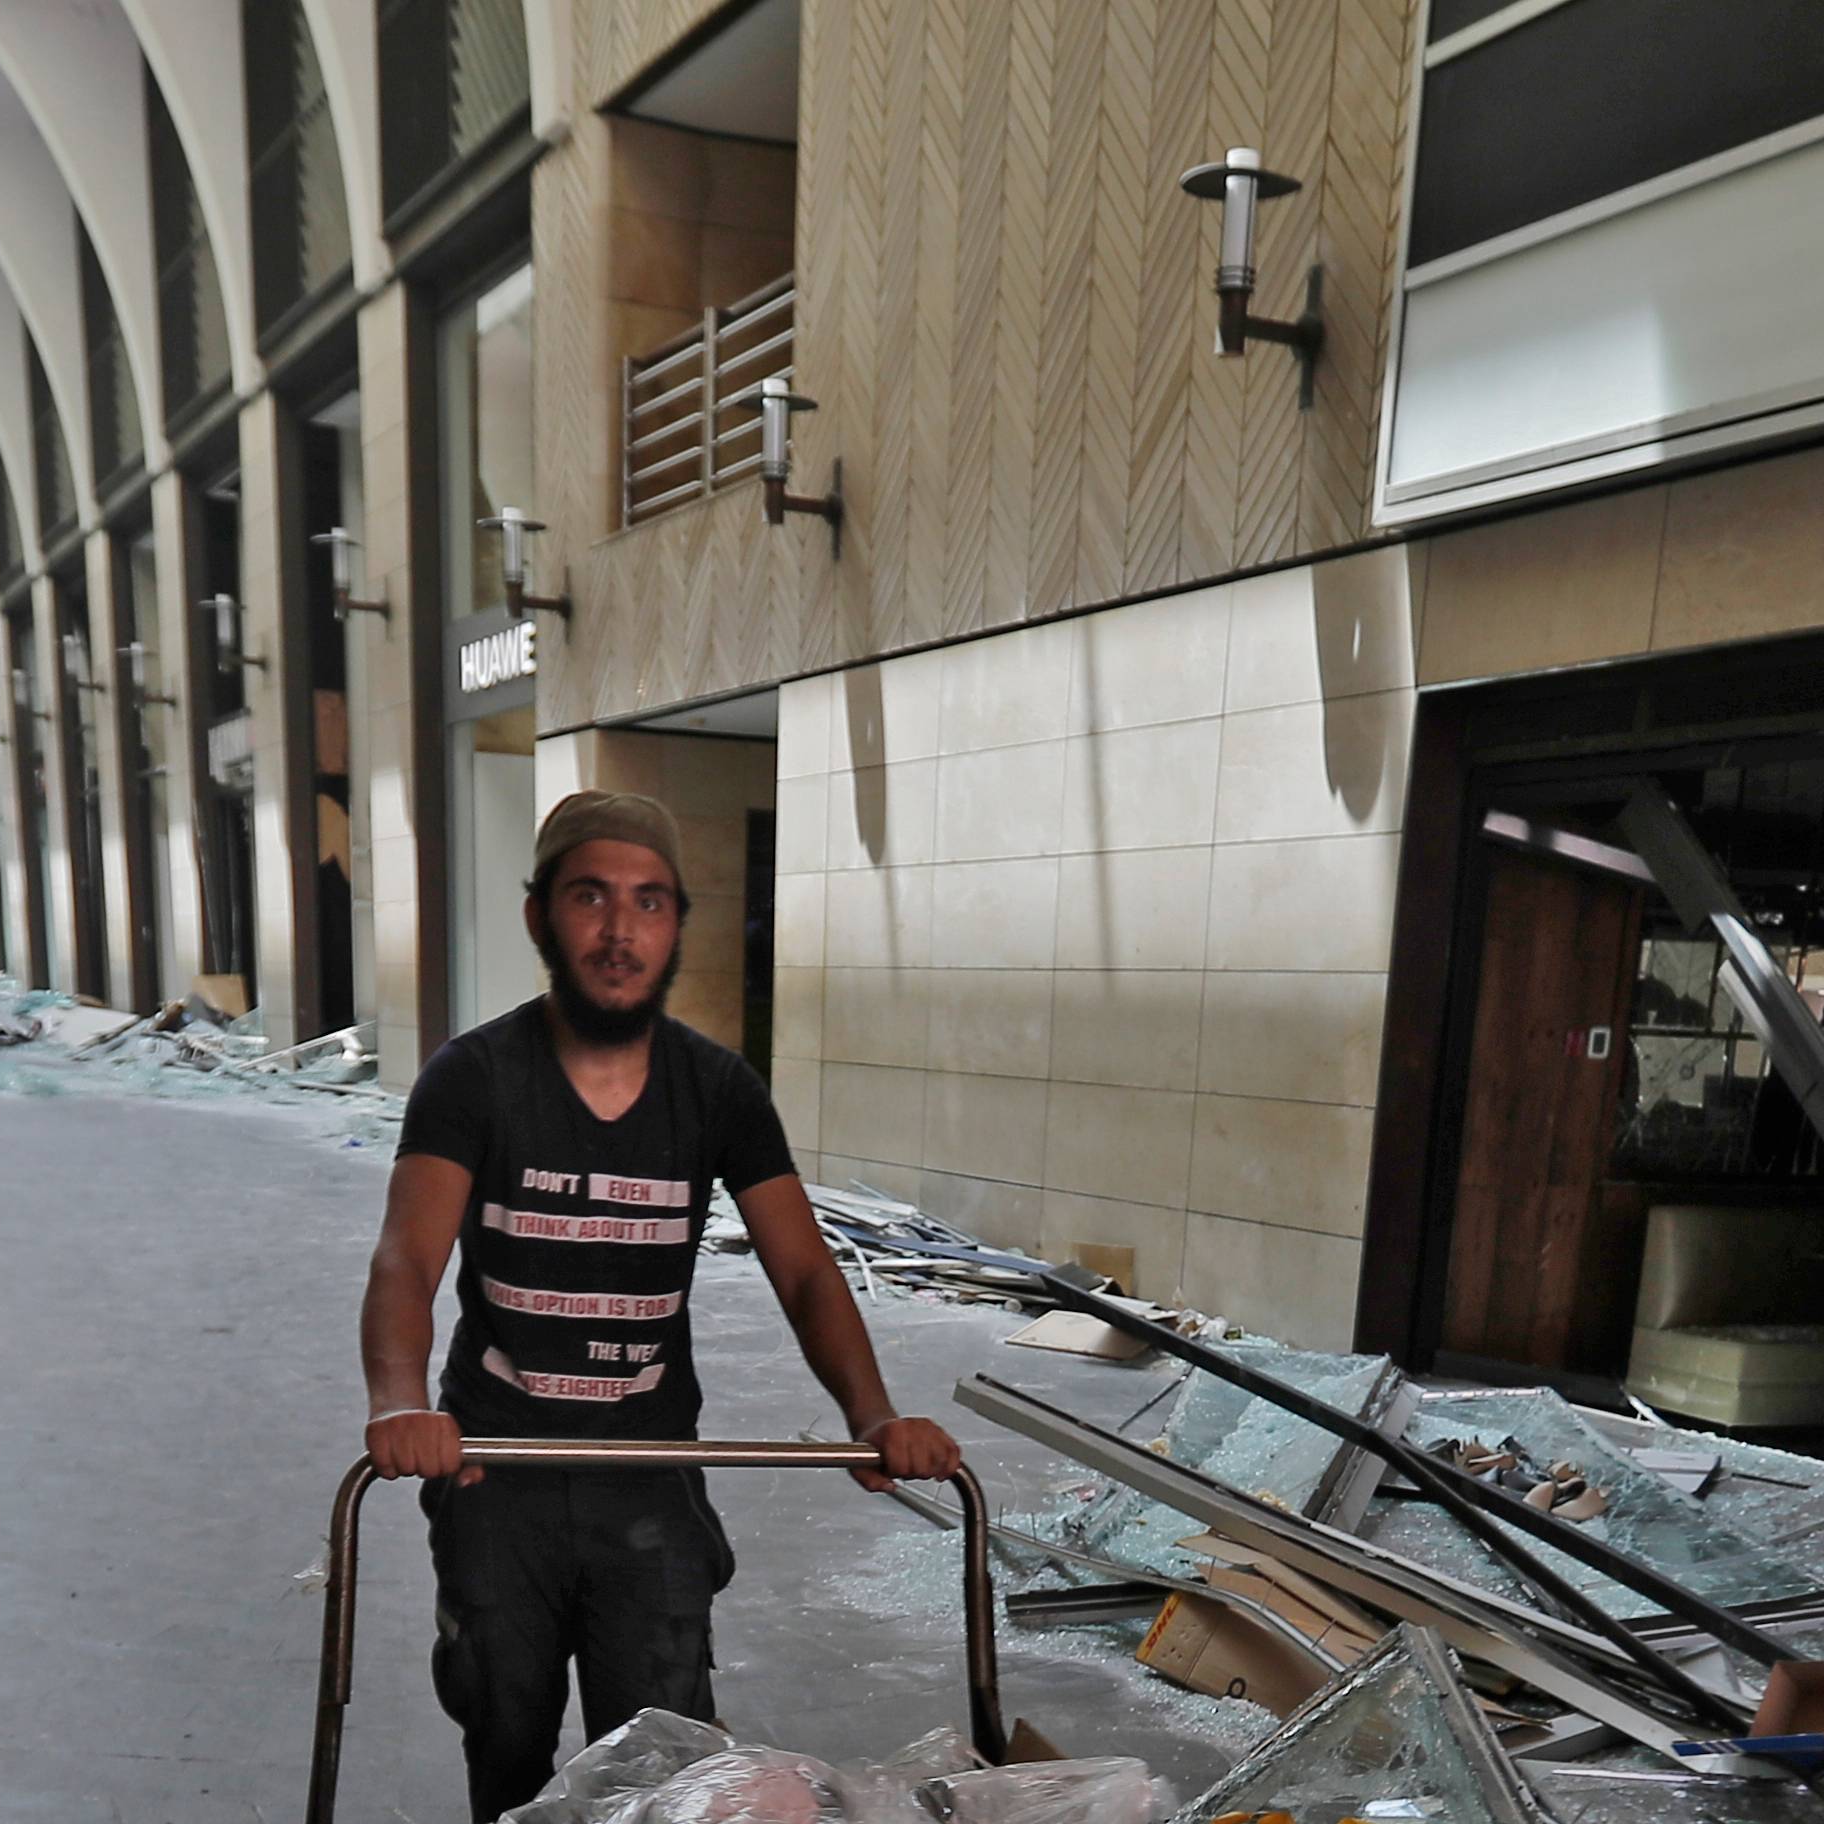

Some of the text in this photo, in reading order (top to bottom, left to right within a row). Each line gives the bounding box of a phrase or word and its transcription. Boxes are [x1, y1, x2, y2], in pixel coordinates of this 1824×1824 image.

[461, 621, 536, 693] HUAWE
[522, 1168, 651, 1201] DON'T EVEN
[514, 1215, 659, 1240] THINK ABOUT IT
[533, 1294, 599, 1314] OPTION
[608, 1298, 626, 1316] IS
[635, 1299, 668, 1318] FOR
[587, 1341, 622, 1361] THE
